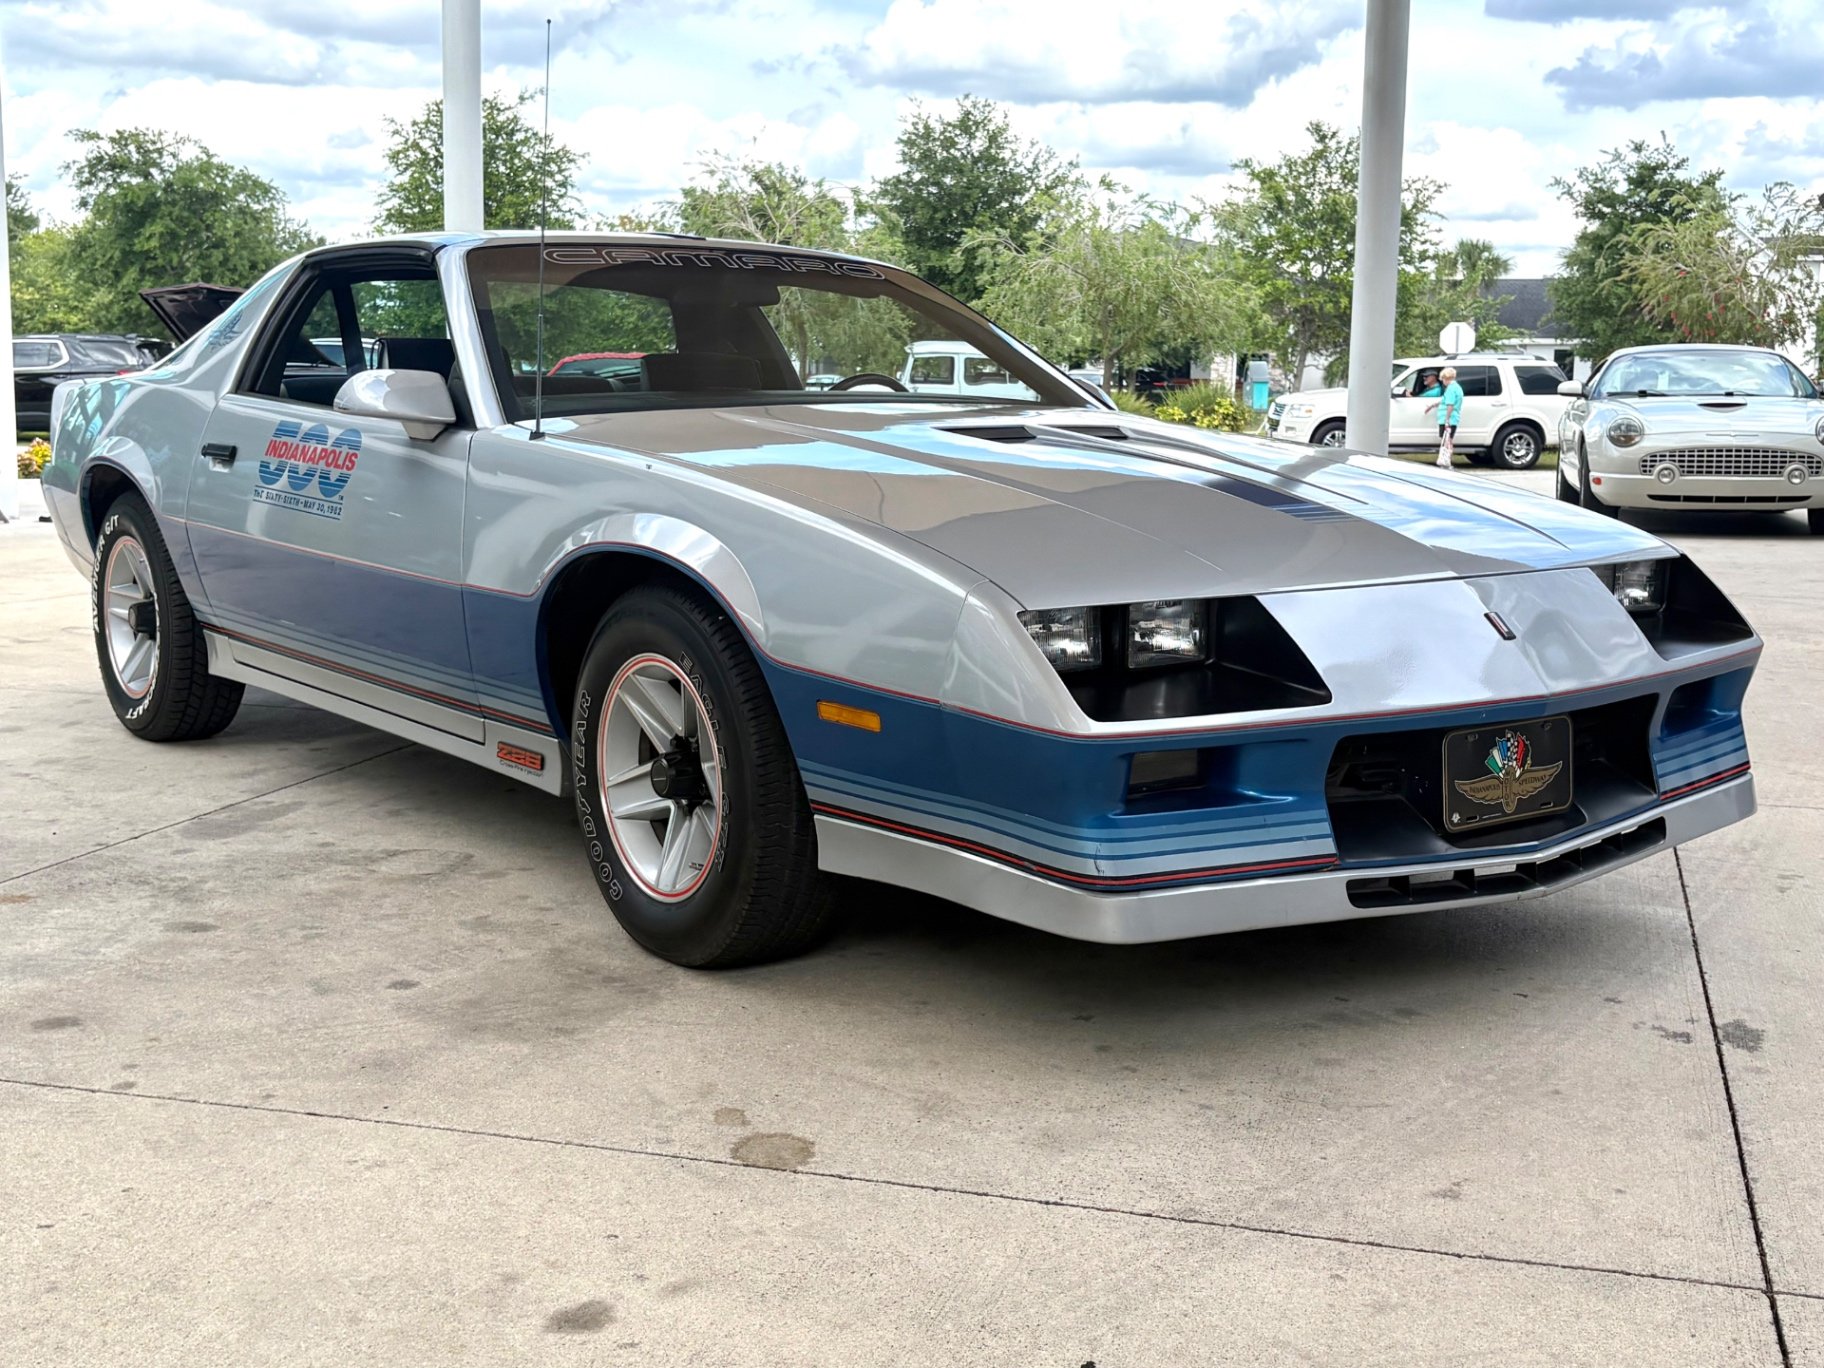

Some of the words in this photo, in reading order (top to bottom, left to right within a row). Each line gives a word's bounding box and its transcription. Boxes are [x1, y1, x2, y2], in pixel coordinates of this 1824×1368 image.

[543, 248, 885, 280] CAMARO
[265, 439, 359, 472] INDIANAPOLIS
[303, 499, 316, 510] MAY
[574, 689, 623, 900] GOODYEAR
